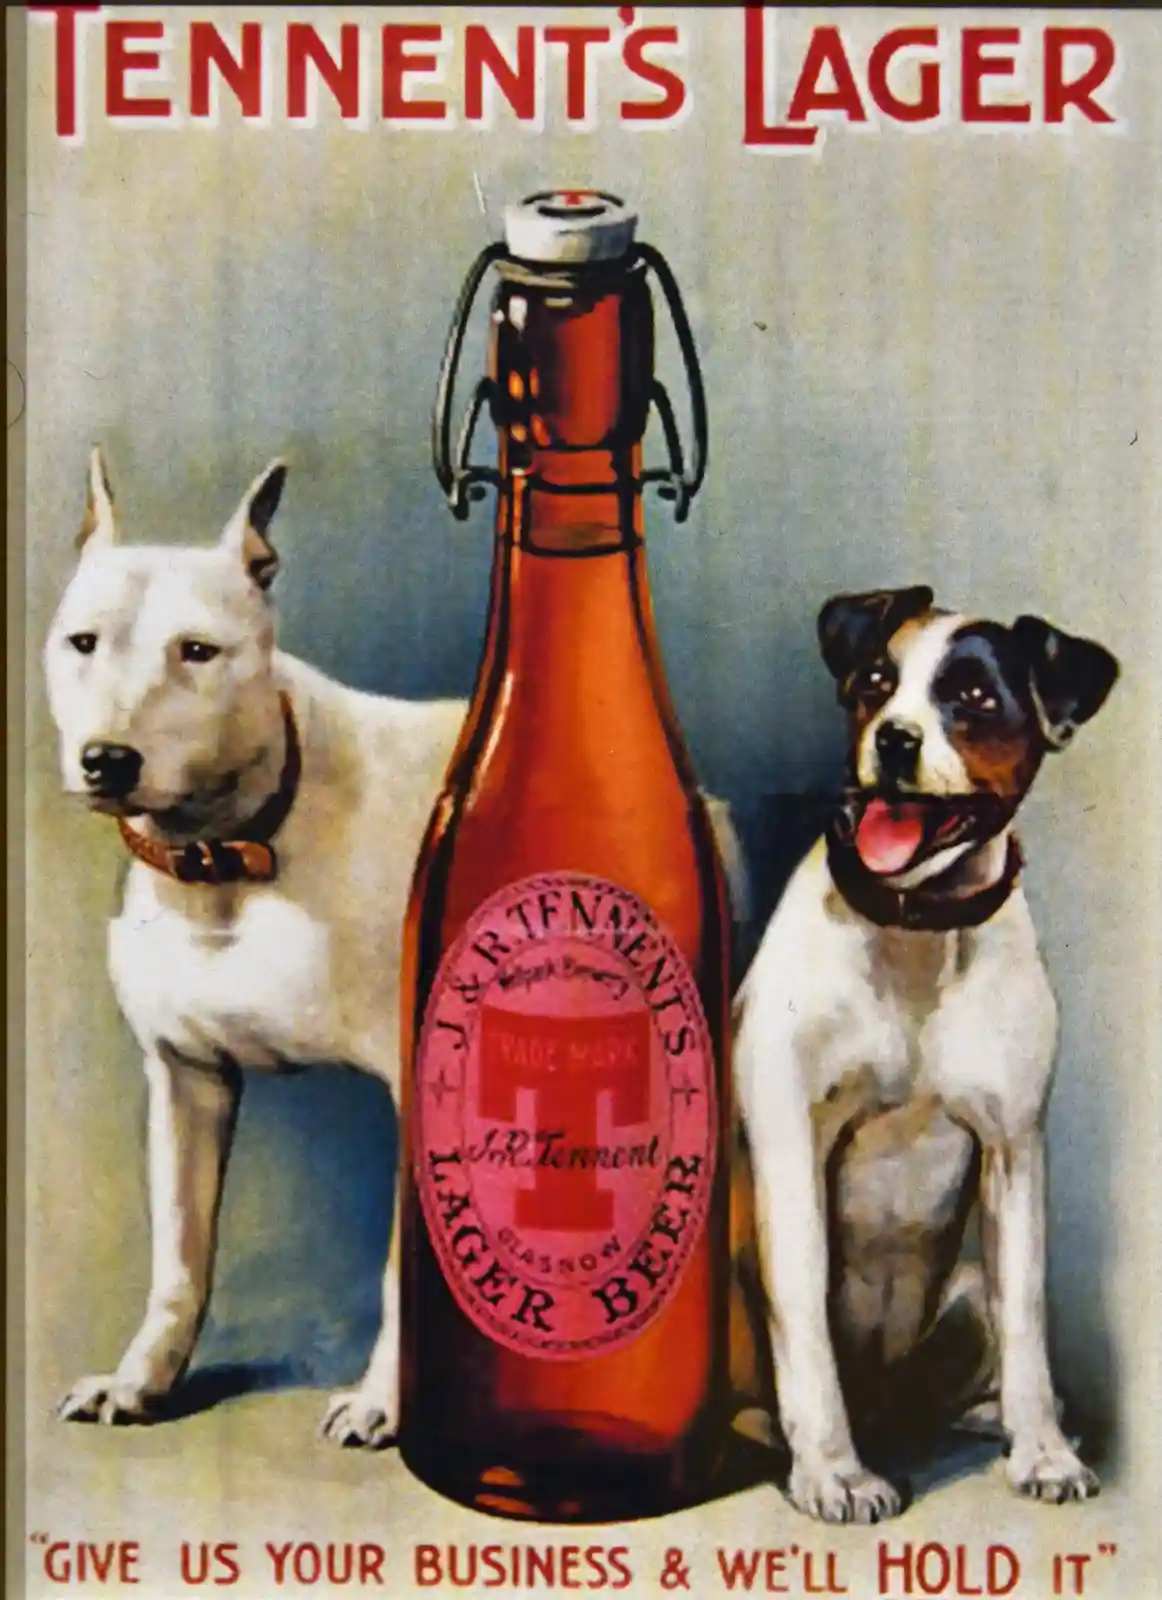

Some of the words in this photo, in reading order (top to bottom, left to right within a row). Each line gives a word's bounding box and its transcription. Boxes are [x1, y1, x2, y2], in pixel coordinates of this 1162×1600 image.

[27, 1, 686, 137] TENNENT'S
[742, 0, 1117, 146] LAGER
[591, 1155, 702, 1325] BEER
[180, 1543, 240, 1586] US
[265, 1543, 386, 1586] YOUR
[414, 1544, 632, 1590] BUSINESS
[659, 1547, 691, 1590] &
[717, 1544, 847, 1593] WE'LL
[878, 1542, 1020, 1596] HOLD
